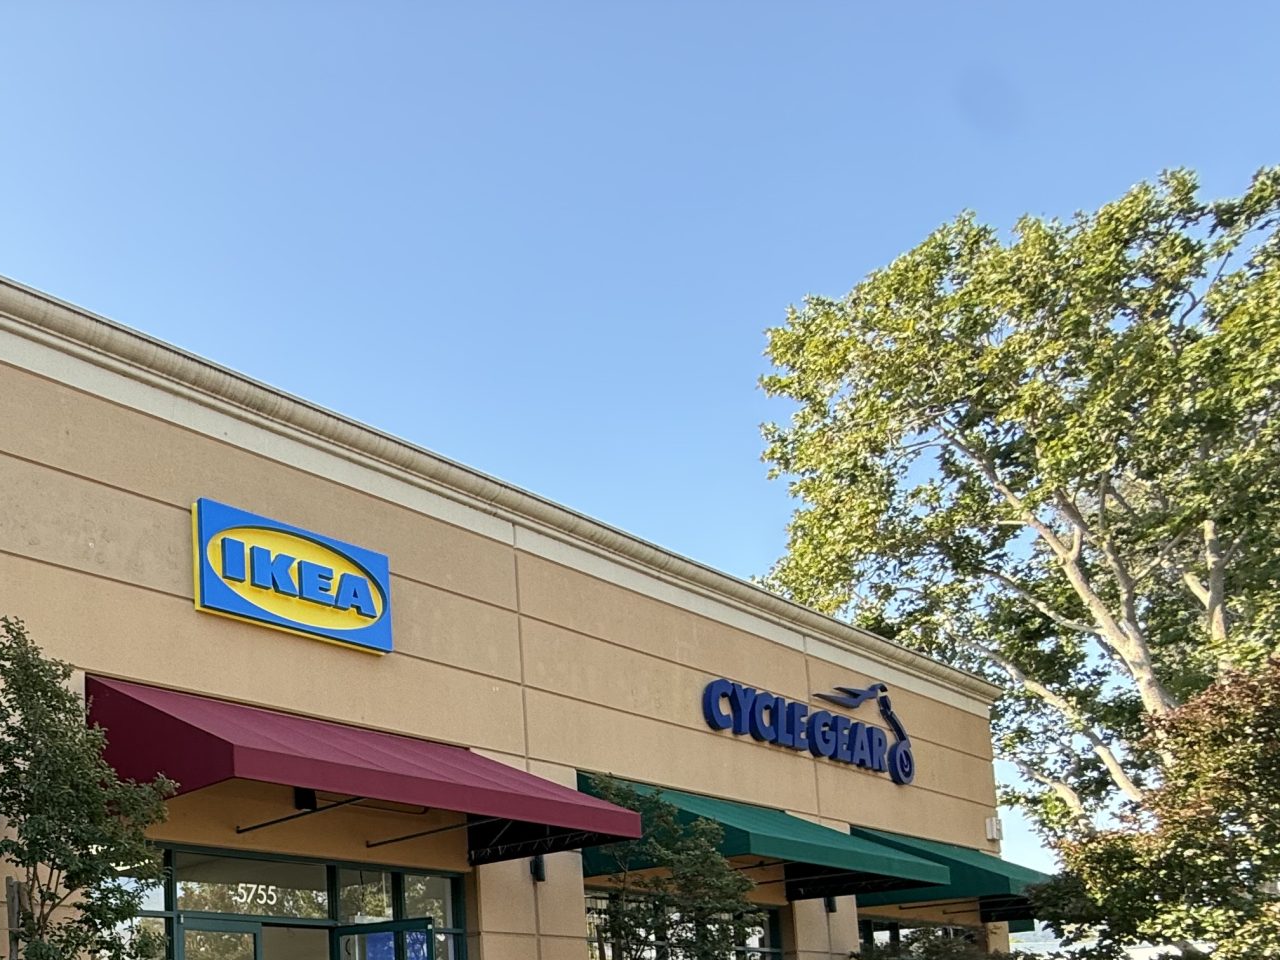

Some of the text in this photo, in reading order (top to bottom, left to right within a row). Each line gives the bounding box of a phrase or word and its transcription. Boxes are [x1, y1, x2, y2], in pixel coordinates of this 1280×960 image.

[221, 536, 377, 618] IKEA
[703, 679, 889, 773] CYCLE GEAR
[237, 883, 277, 905] 5755
